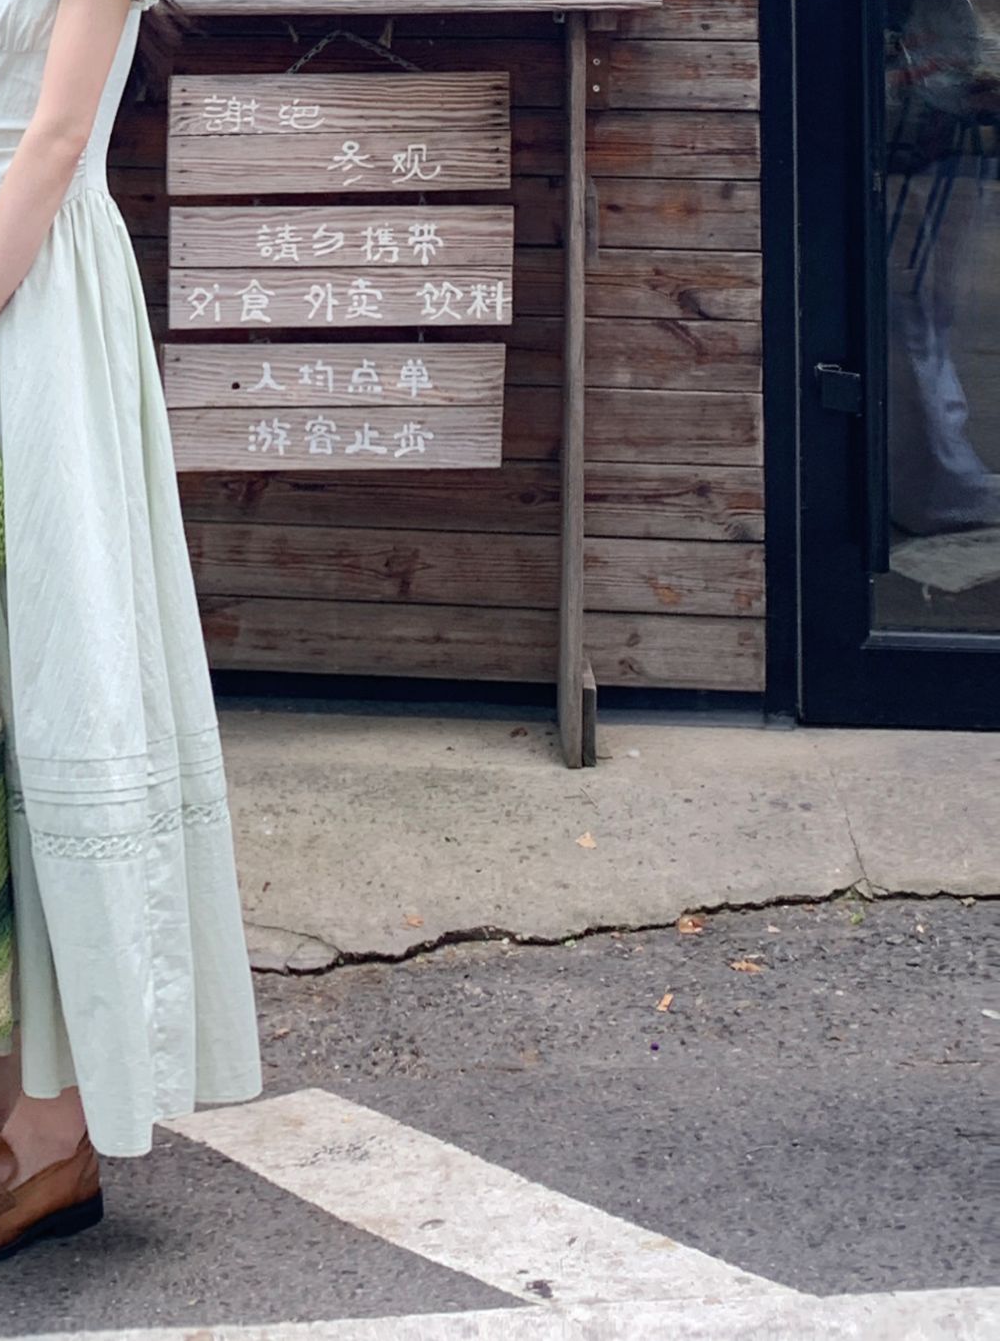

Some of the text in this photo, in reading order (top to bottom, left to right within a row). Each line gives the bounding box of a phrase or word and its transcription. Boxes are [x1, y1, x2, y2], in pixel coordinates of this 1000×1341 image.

[187, 279, 275, 323] 外食
[304, 278, 383, 323] 外卖
[246, 358, 434, 398] 人均点单
[247, 415, 435, 458] 游客止步
